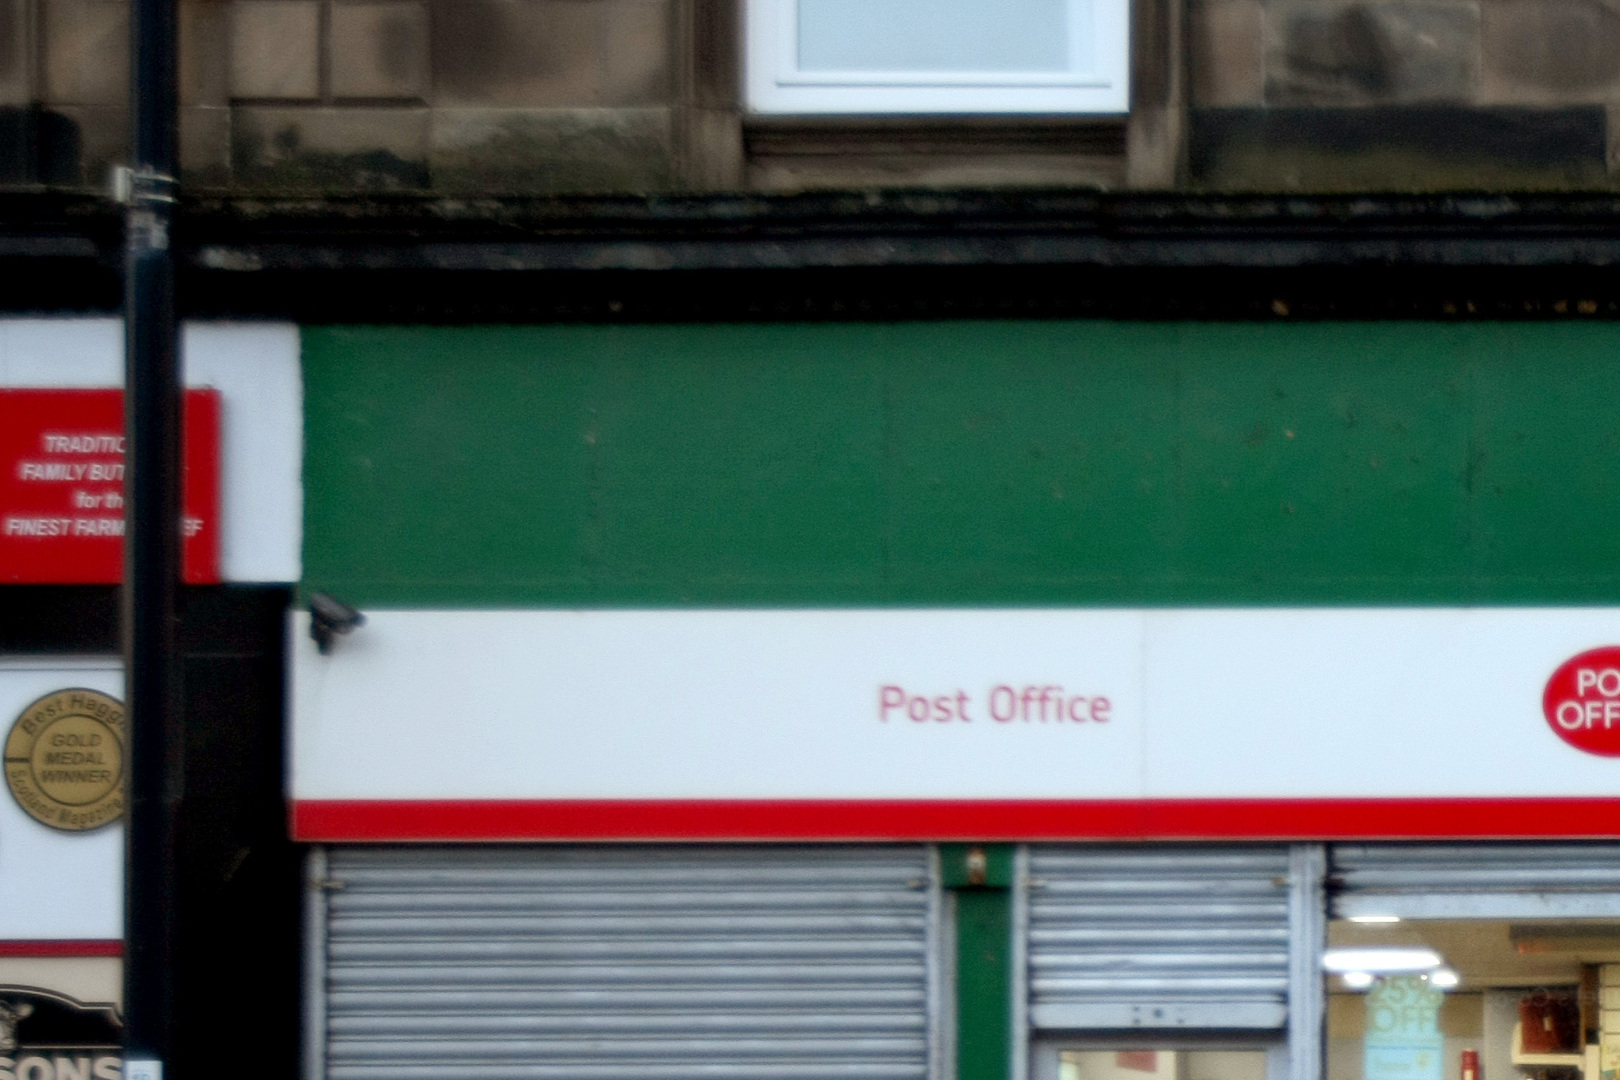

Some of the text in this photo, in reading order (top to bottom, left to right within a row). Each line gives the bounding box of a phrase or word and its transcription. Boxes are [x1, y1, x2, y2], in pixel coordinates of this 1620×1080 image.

[44, 435, 126, 453] TRADITIO
[22, 463, 125, 481] FAMILY BUT
[77, 490, 101, 509] for
[7, 518, 71, 536] FINEST
[880, 685, 1112, 723] Post Office
[51, 733, 103, 748] GOLD
[45, 752, 105, 765] MEDAL
[40, 769, 111, 783] WINNER
